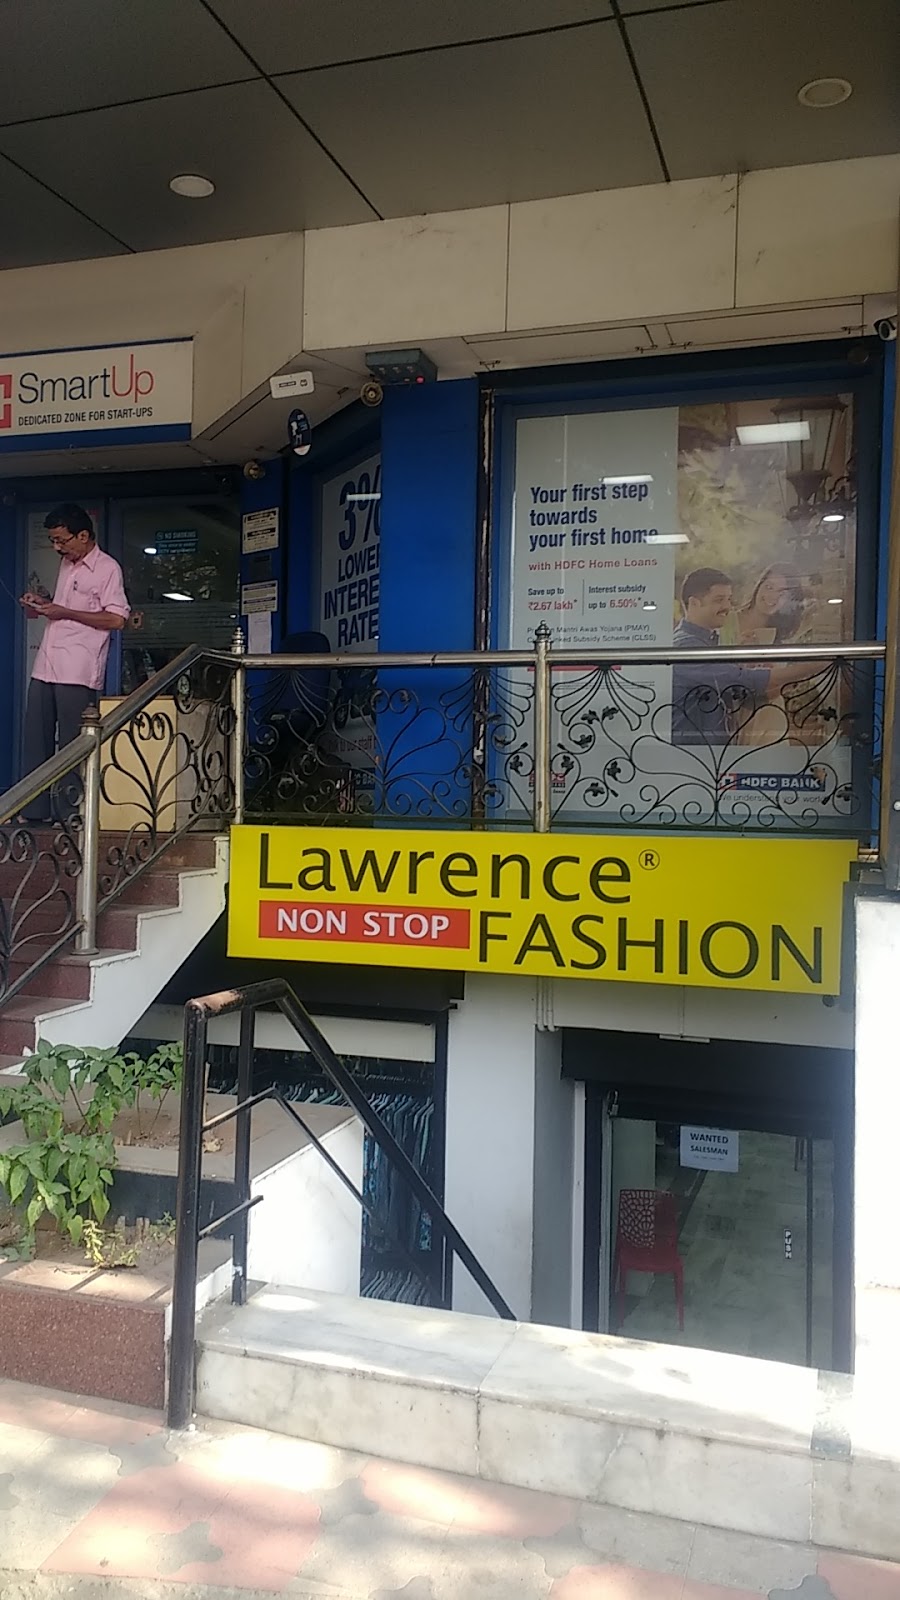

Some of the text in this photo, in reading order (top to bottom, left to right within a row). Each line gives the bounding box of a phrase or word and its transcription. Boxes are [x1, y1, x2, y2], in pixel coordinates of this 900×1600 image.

[18, 354, 154, 403] SmartUp
[18, 407, 153, 426] DEDICATED ZONE FOR START-UPS
[530, 482, 649, 504] Your first step
[529, 507, 598, 526] towards
[529, 533, 566, 552] your
[571, 528, 606, 547] first
[338, 543, 380, 583] LOWE
[528, 558, 657, 571] with HDFC Home Loans
[324, 573, 379, 620] INTERE
[528, 587, 564, 597] Save up to
[588, 584, 646, 595] Interest subsidy
[588, 602, 598, 610] up
[599, 601, 607, 609] to
[741, 777, 777, 787] HDFC
[259, 832, 631, 904] Lawrence
[276, 908, 450, 940] NON STOP
[478, 911, 823, 984] FASHION
[690, 1132, 729, 1144] WANTED
[690, 1145, 729, 1156] SALESMAN
[784, 1230, 792, 1259] PUSH
